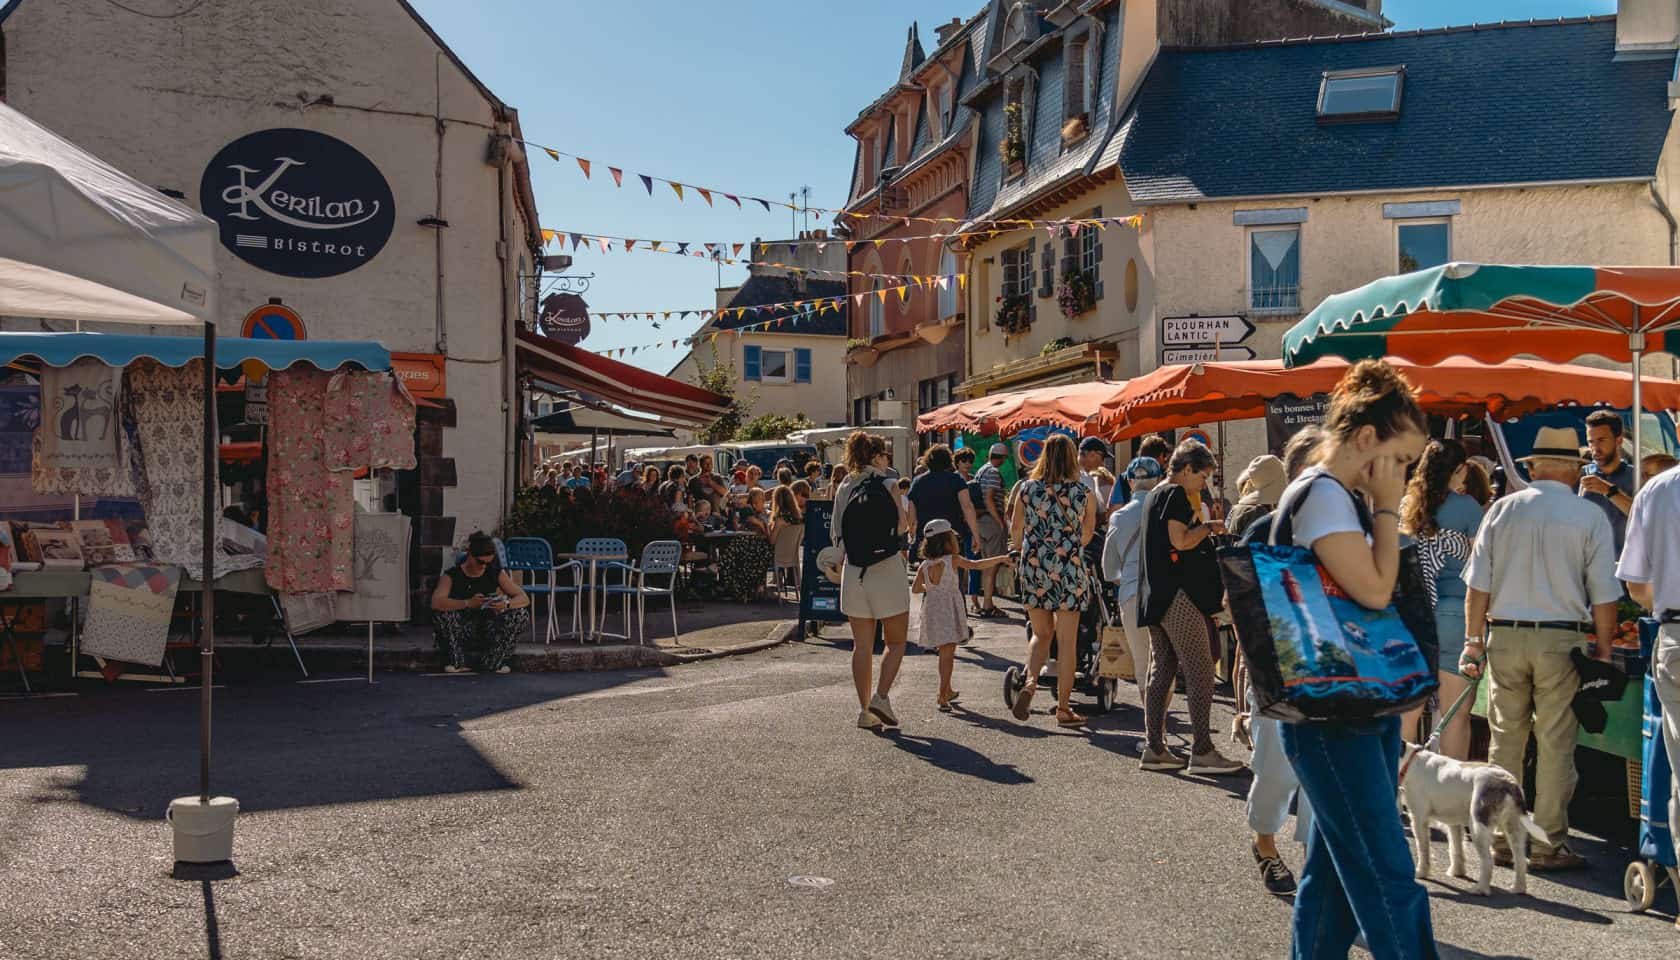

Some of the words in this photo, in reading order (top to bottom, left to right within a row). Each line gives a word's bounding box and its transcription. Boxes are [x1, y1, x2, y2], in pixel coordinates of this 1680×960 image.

[1167, 320, 1229, 330] PLOURHAN
[1167, 332, 1209, 341] LANTIC
[1167, 351, 1217, 362] Cimetièr
[1284, 415, 1295, 425] de
